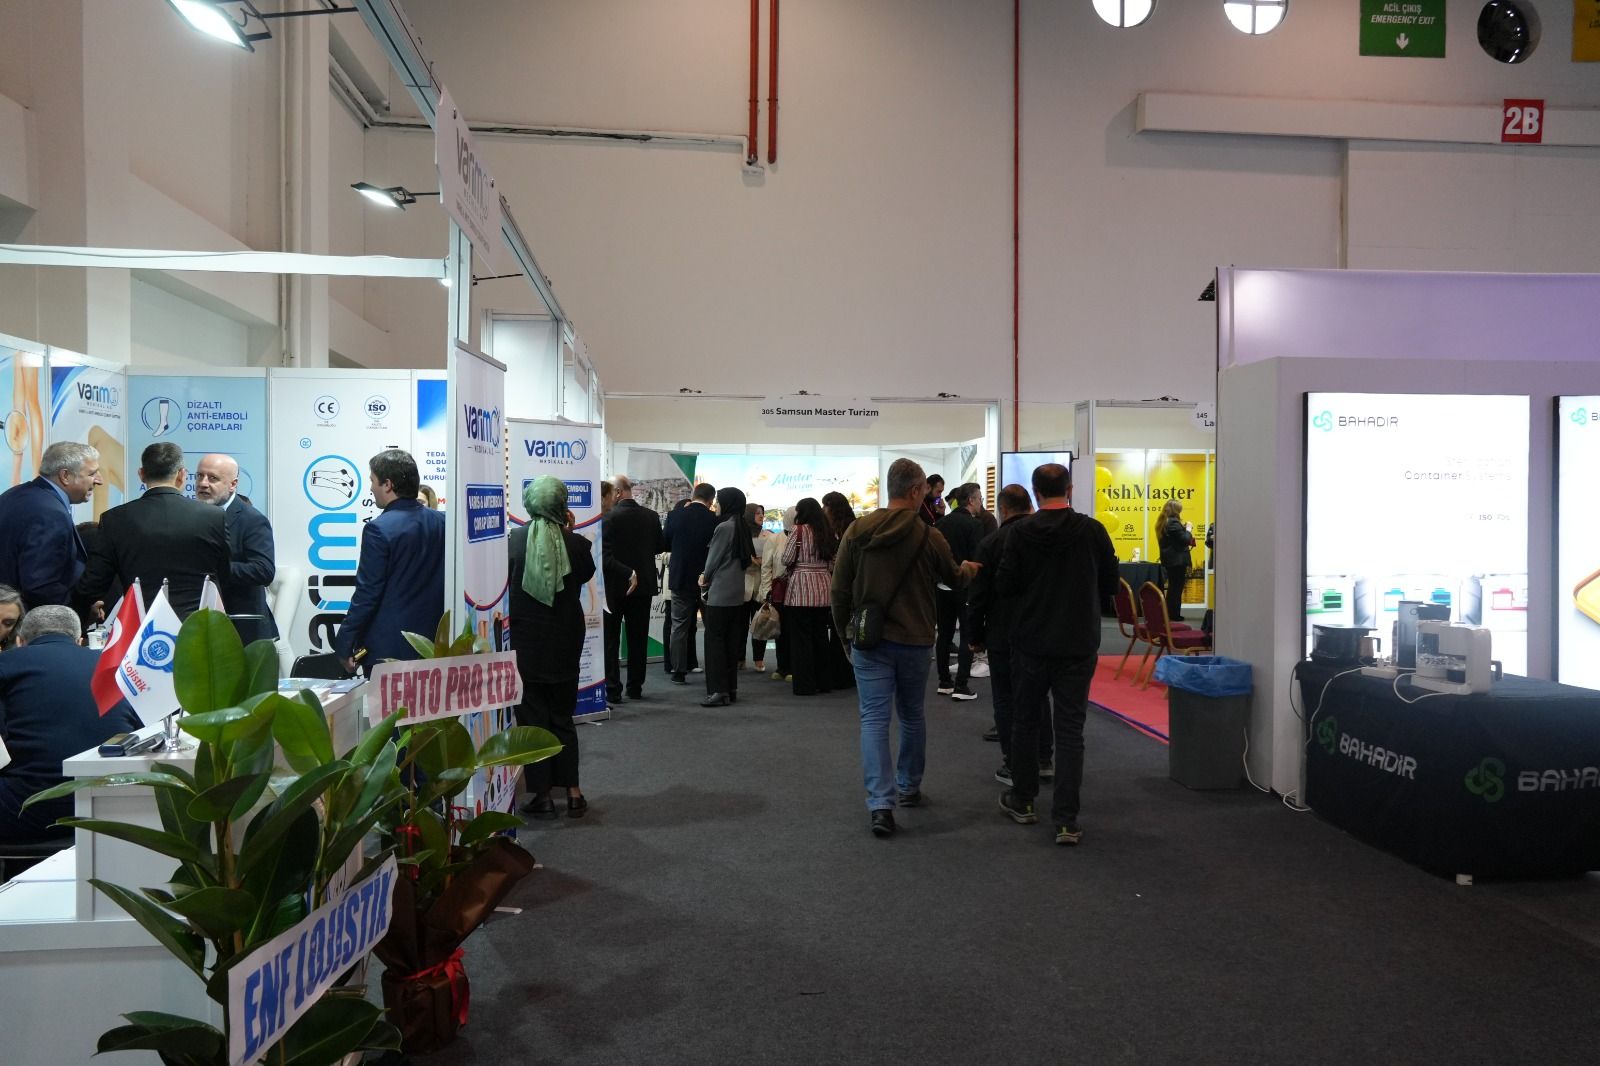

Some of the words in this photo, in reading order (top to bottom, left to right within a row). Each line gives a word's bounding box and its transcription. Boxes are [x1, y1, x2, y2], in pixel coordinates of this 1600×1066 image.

[1383, 2, 1401, 13] ACİL
[1401, 3, 1422, 15] ÇIKIŞ
[1371, 14, 1417, 25] EMERGENCY
[1418, 16, 1436, 25] EXIT
[1504, 107, 1539, 135] 2B
[187, 400, 222, 409] DİZALTI
[368, 404, 387, 412] ISO
[187, 411, 248, 421] ANTİ-EMBOLİ
[776, 407, 813, 416] Samsun
[815, 407, 846, 417] Master
[848, 408, 879, 417] Turizm
[187, 422, 243, 432] ÇORAPLARI
[1404, 469, 1463, 481] Container
[380, 667, 442, 720] LENTO
[445, 663, 483, 712] PRO
[487, 660, 518, 705] LTD.
[1517, 766, 1600, 792] BAHA
[243, 942, 294, 1063] ENF
